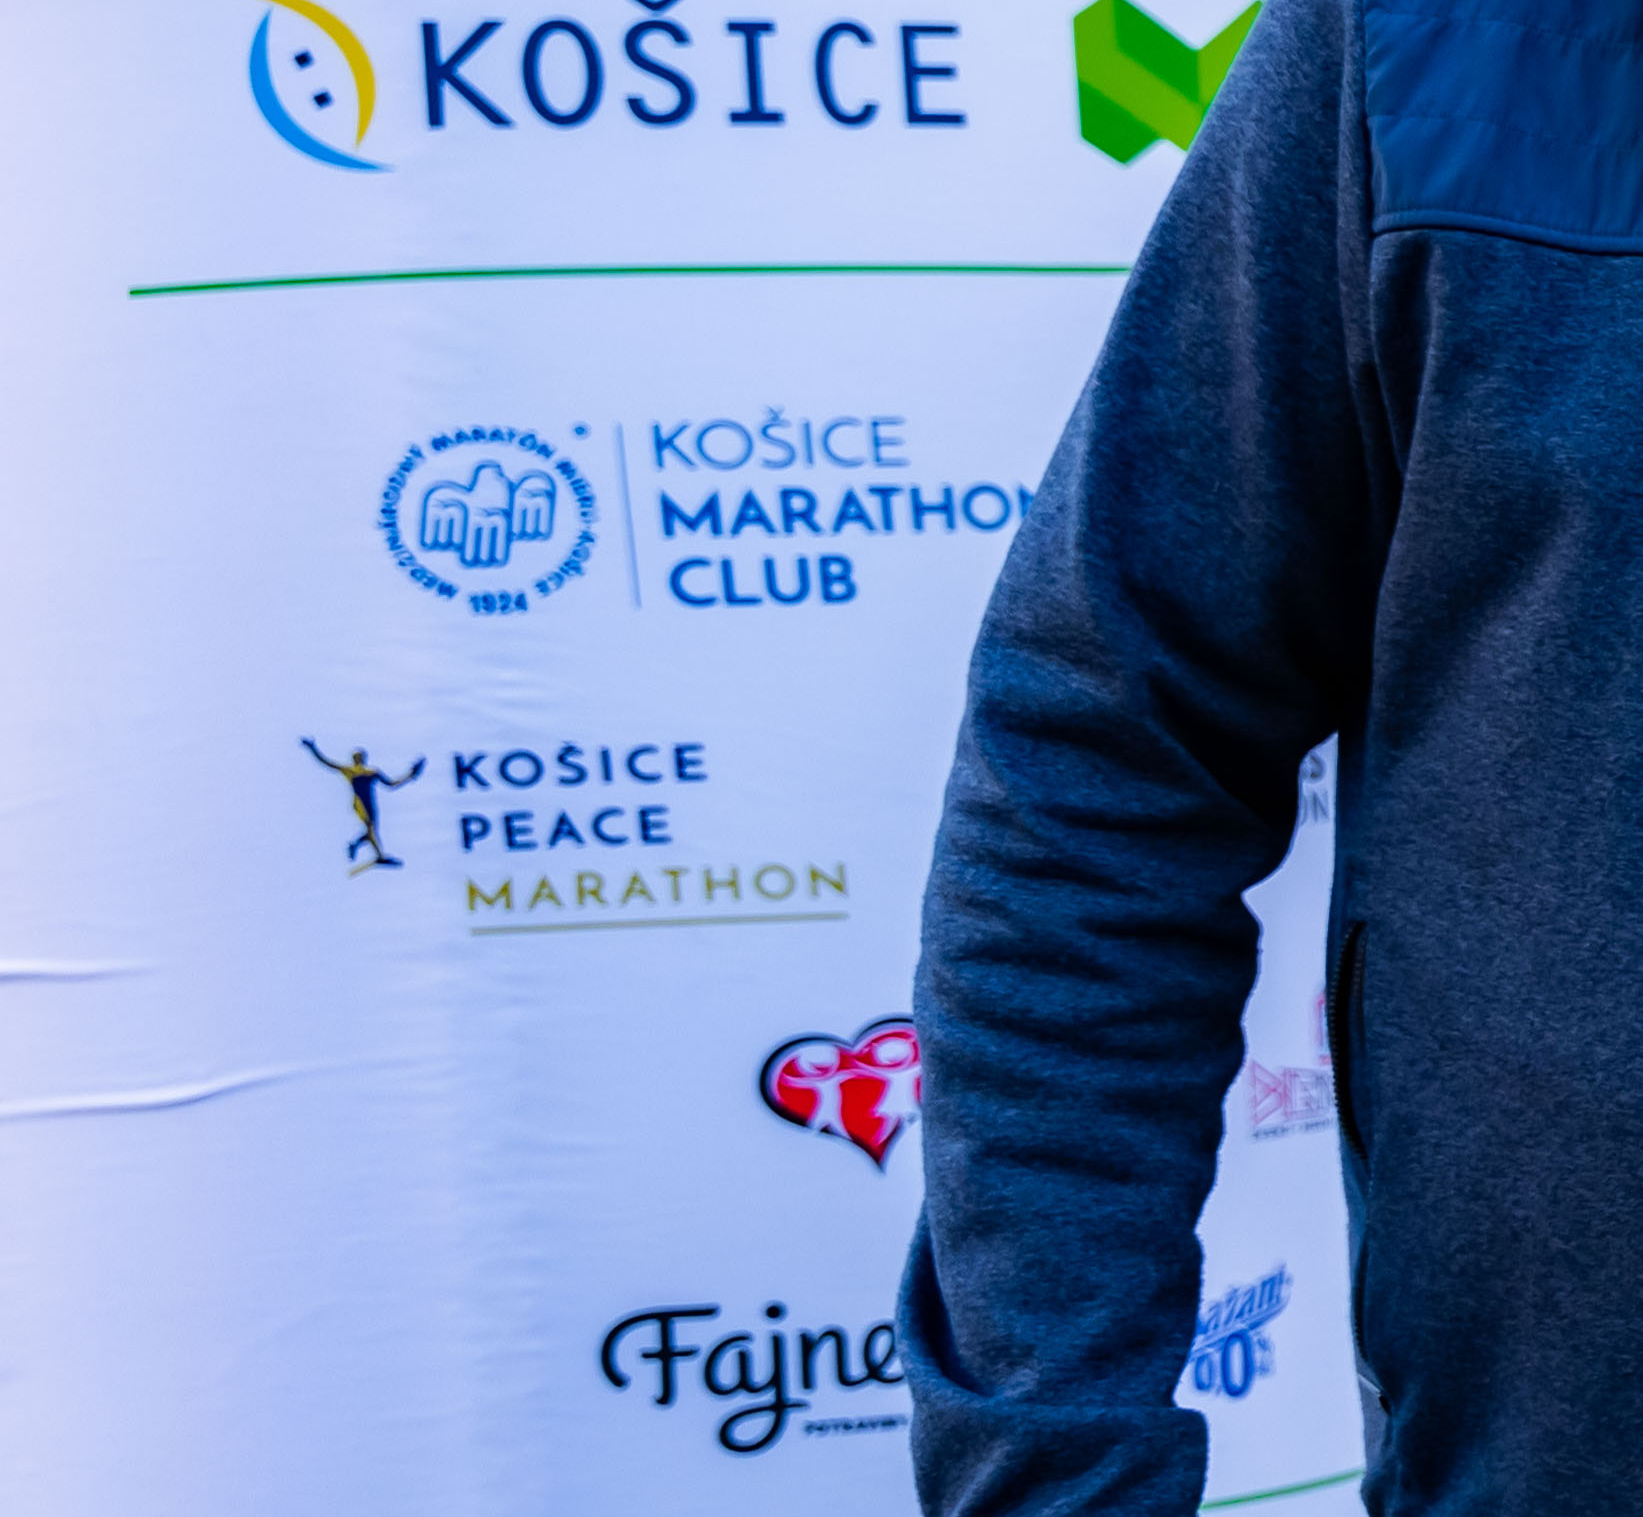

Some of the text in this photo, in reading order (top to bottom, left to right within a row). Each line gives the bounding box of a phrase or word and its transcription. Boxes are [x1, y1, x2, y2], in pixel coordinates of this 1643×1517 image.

[652, 405, 912, 471] KOŠICE
[468, 592, 529, 615] 1924
[668, 553, 858, 607] CLUB
[452, 741, 709, 791] KOŠICE
[460, 805, 673, 851] PEACE
[465, 862, 851, 913] MARATHON
